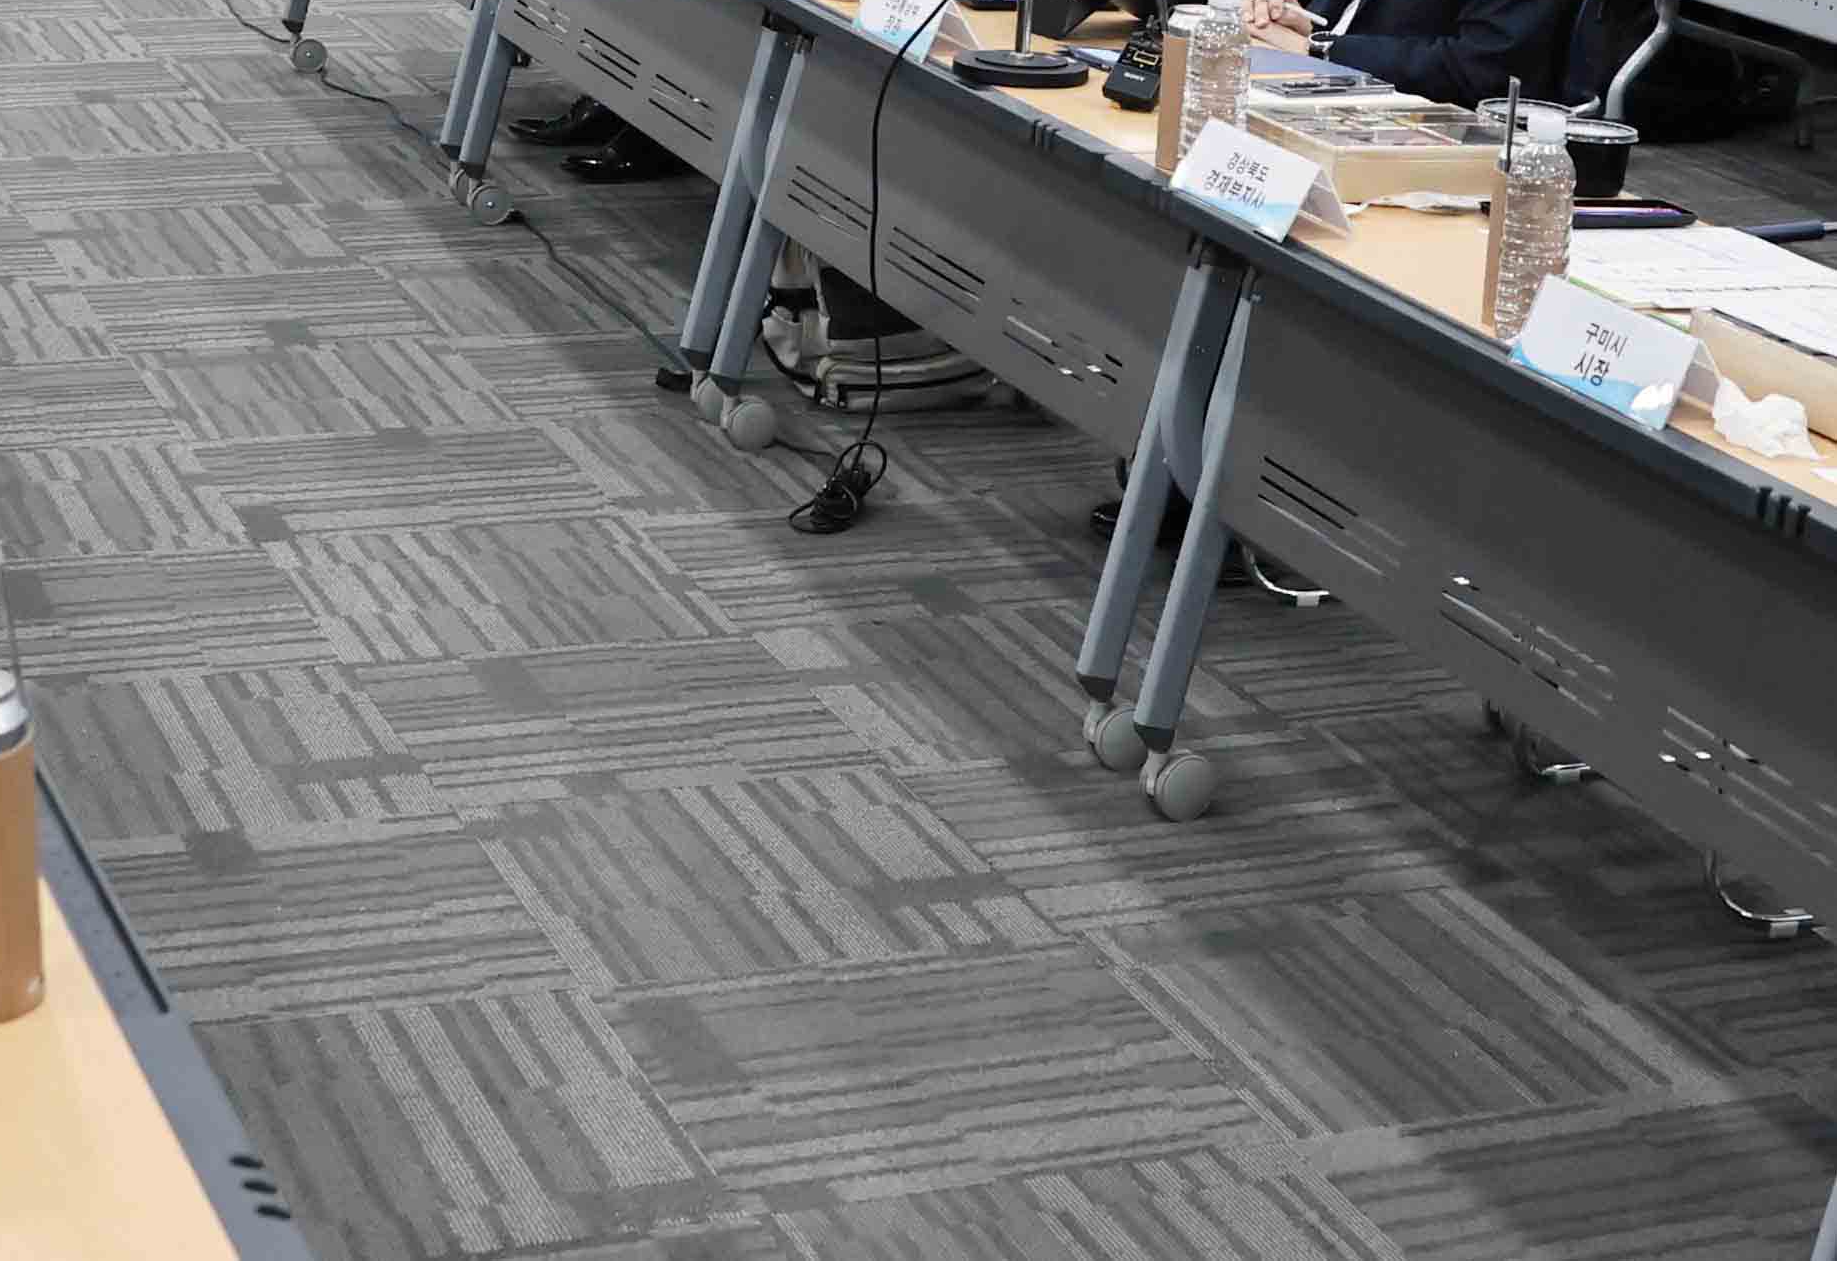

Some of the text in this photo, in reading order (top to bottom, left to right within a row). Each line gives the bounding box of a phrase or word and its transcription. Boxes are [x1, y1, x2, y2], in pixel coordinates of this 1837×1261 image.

[1226, 151, 1271, 184] 경상북도
[1202, 169, 1268, 212] 경제부지사
[1584, 321, 1630, 358] 구미시
[1572, 351, 1612, 388] 시장
